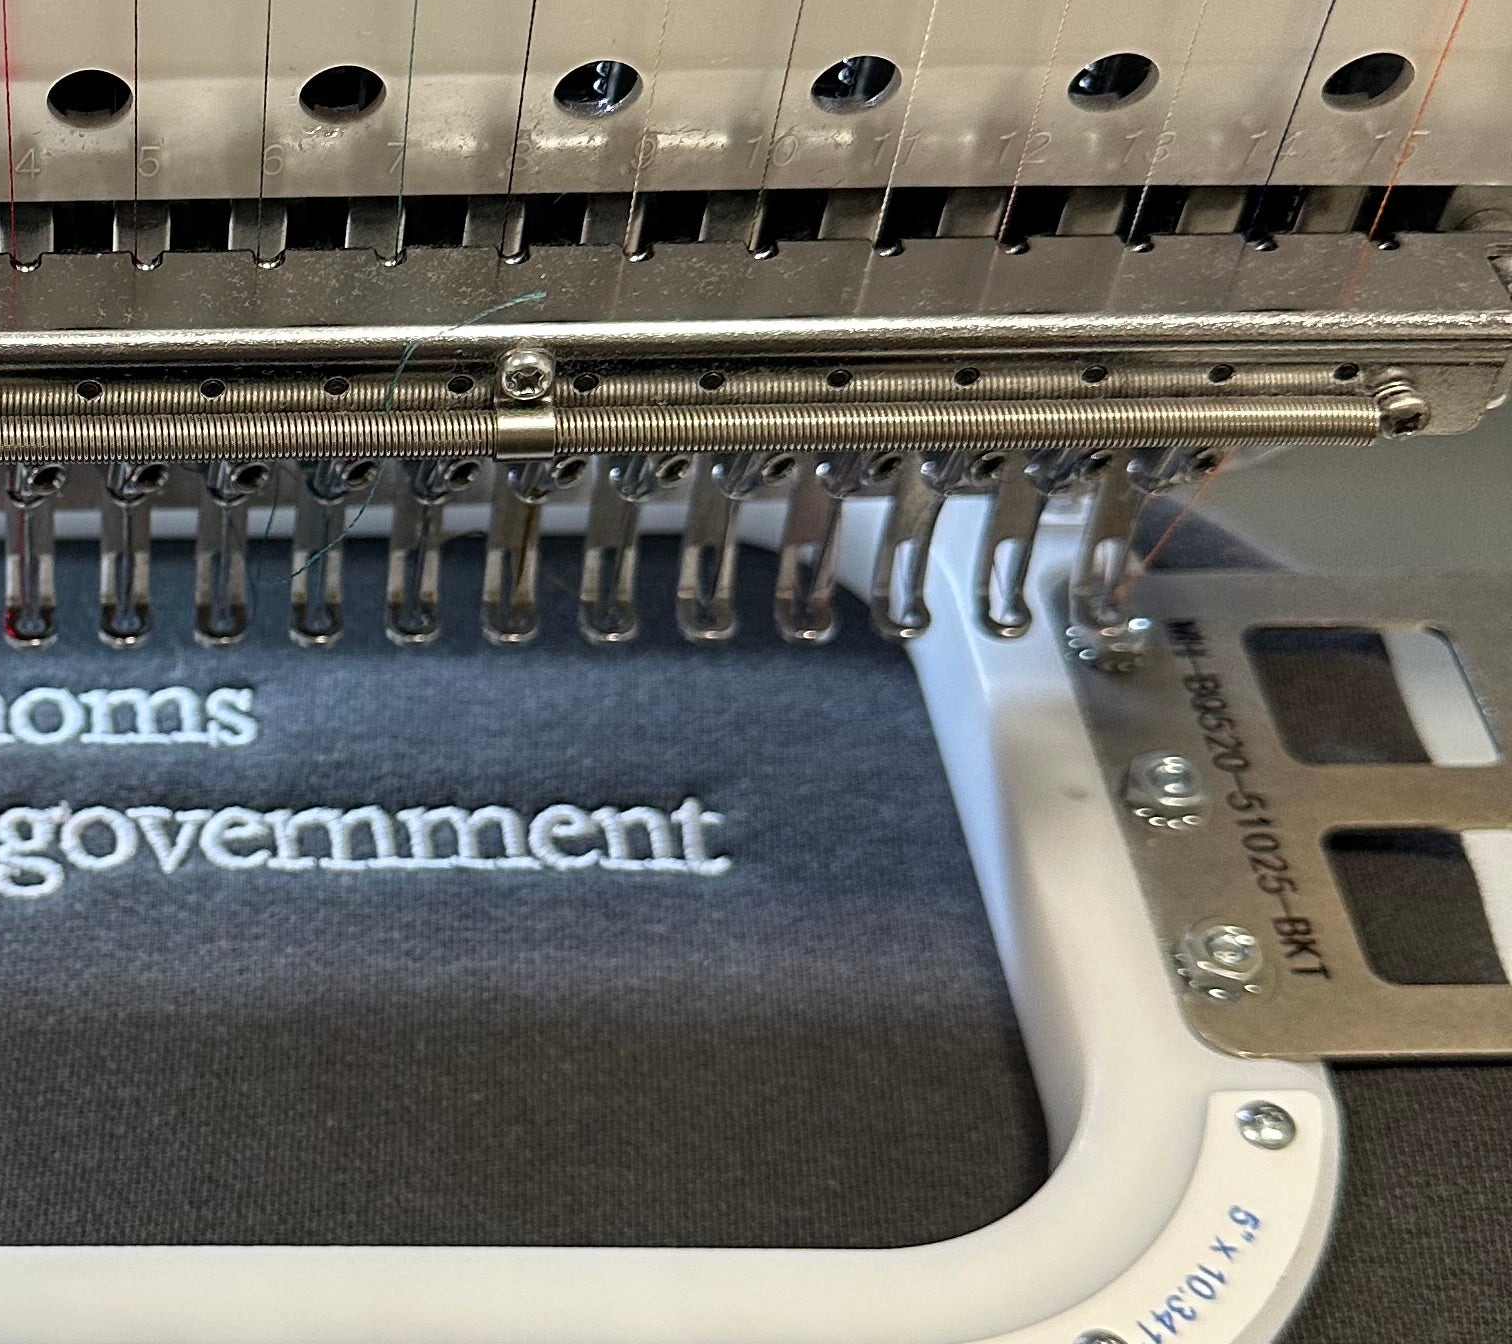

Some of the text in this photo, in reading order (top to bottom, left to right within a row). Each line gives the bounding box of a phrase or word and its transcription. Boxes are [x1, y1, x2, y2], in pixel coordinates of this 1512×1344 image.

[14, 147, 41, 179] 4
[138, 145, 162, 177] 5
[262, 143, 285, 176] 6
[386, 141, 407, 175] 7
[630, 138, 657, 169] 9
[745, 133, 800, 168] 10
[872, 132, 923, 167] 11
[999, 131, 1053, 165] 12
[1119, 130, 1177, 165] 13
